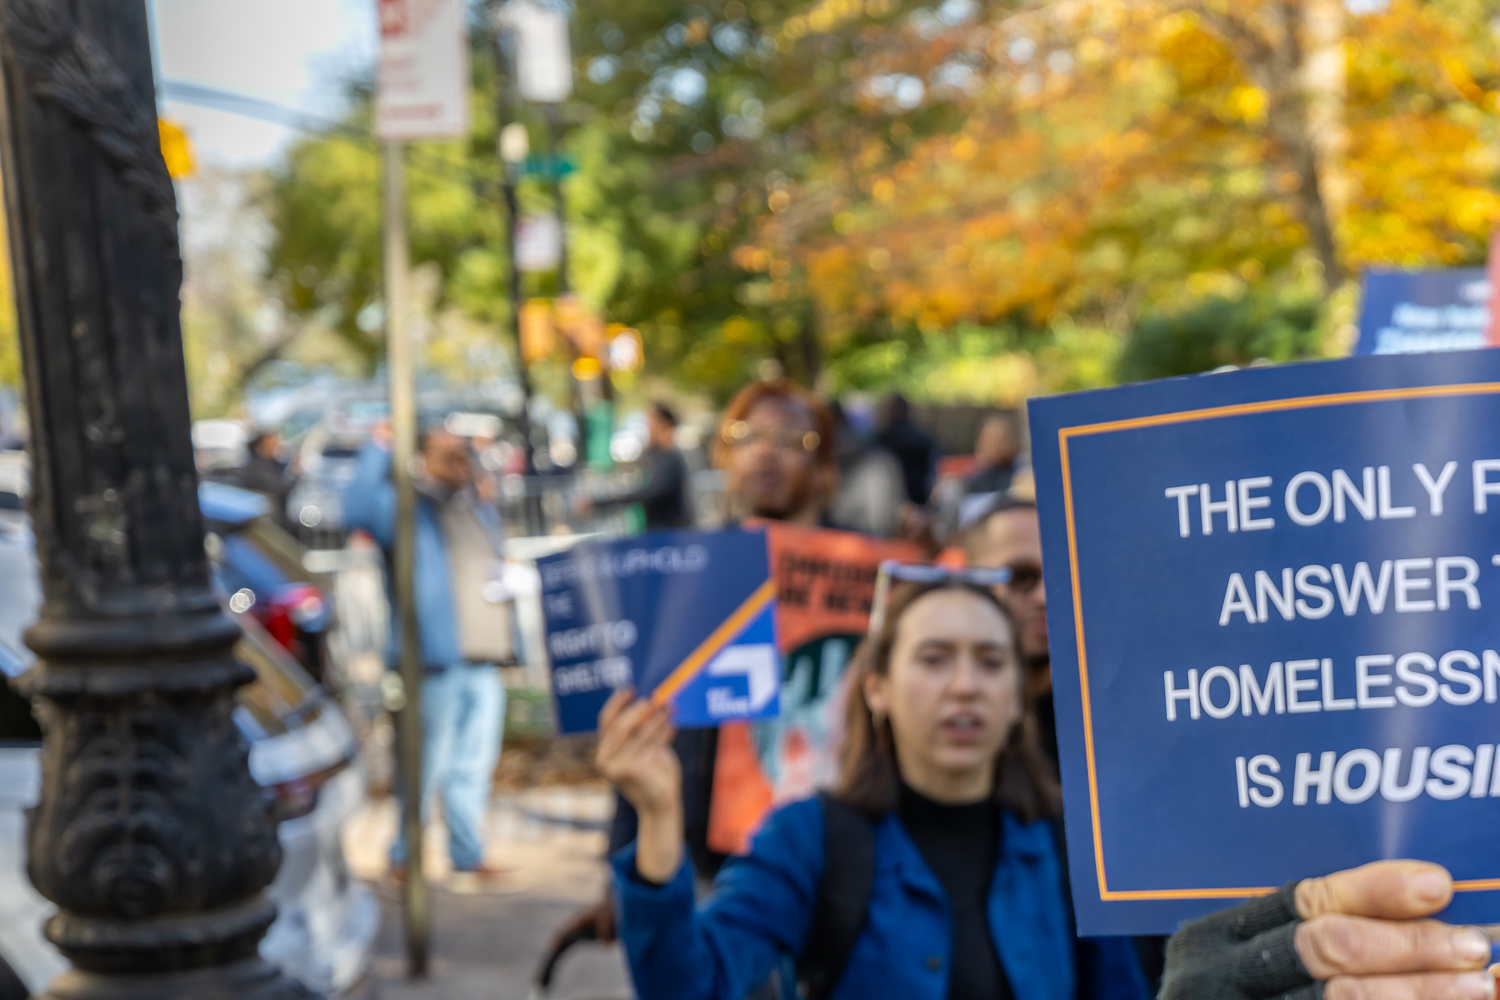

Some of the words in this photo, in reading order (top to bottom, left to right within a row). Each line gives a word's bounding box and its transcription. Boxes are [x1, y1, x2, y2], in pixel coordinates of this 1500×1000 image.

[1164, 476, 1275, 538] THE
[1284, 461, 1458, 526] ONLY
[1219, 556, 1481, 626] ANSWER
[554, 655, 633, 696] SHELTER
[1236, 755, 1283, 808] IS
